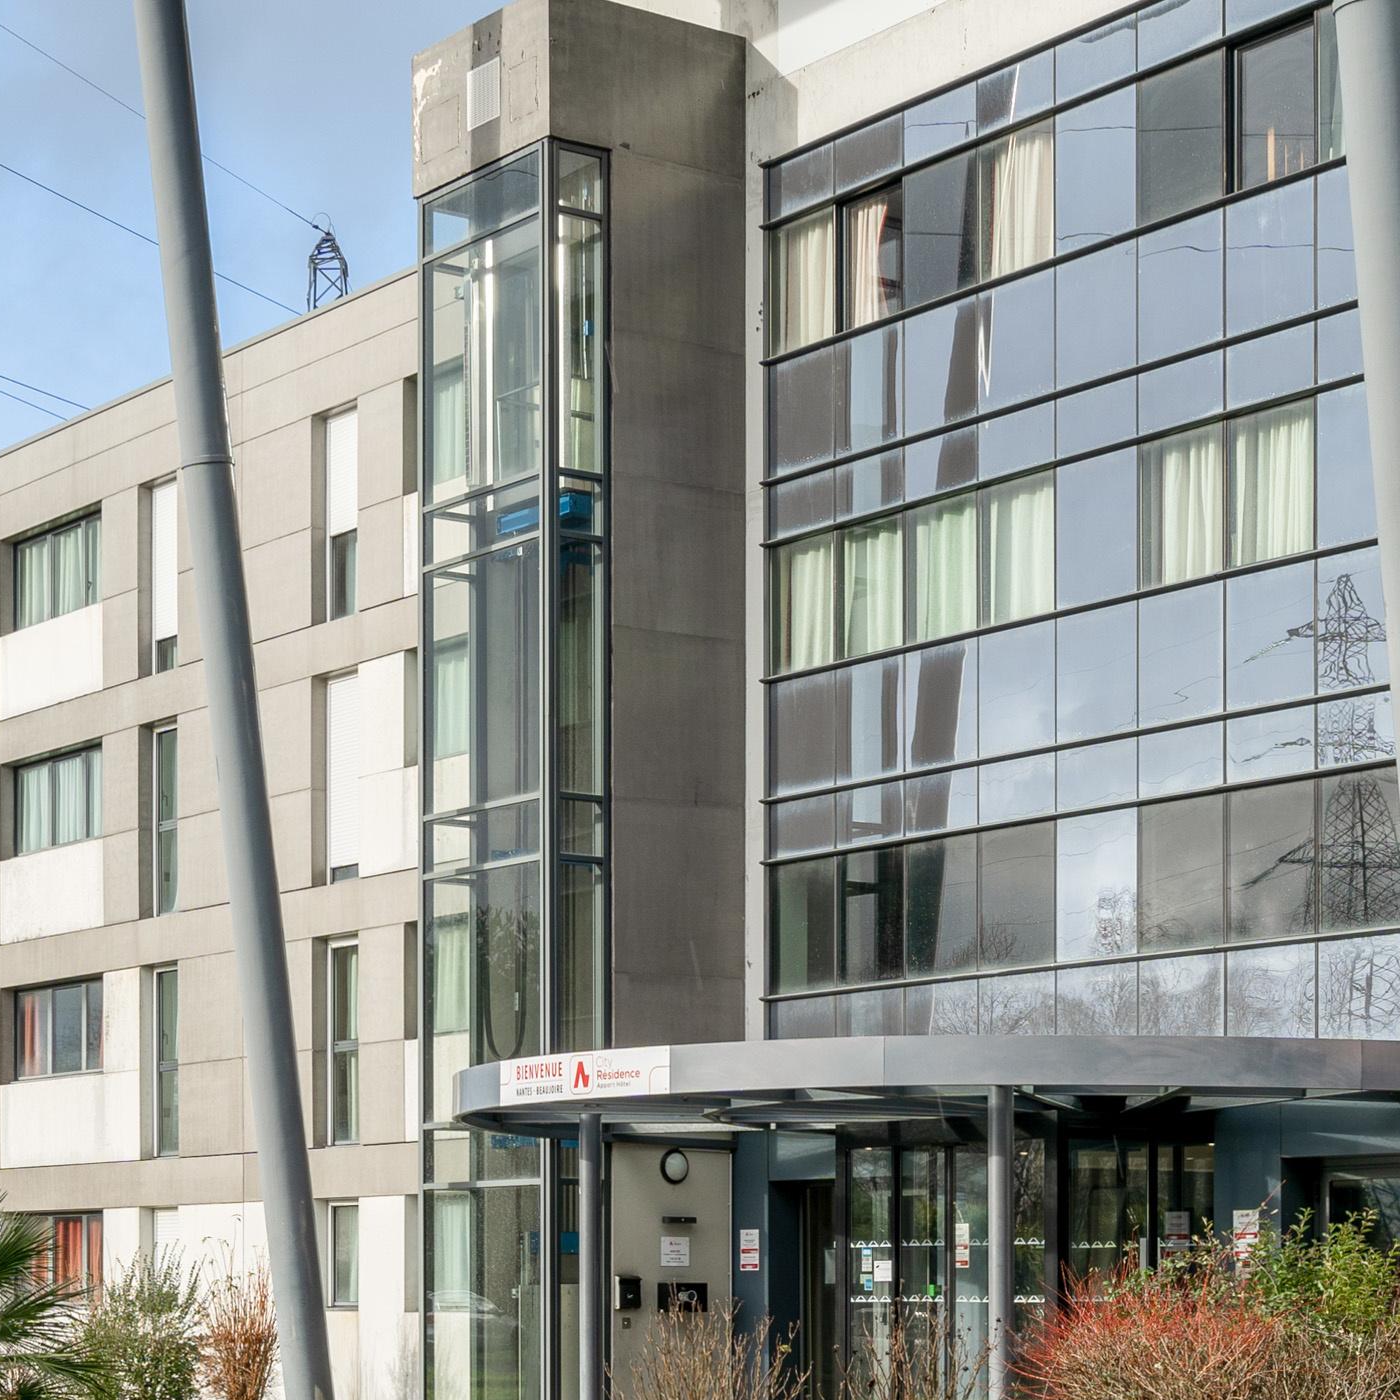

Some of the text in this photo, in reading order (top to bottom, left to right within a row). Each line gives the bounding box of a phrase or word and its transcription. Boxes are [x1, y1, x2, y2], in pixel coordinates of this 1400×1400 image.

[596, 1055, 613, 1069] City
[516, 1061, 563, 1081] BIENVENUE
[516, 1086, 532, 1097] NANTES
[536, 1084, 563, 1096] BEAUJOIRE
